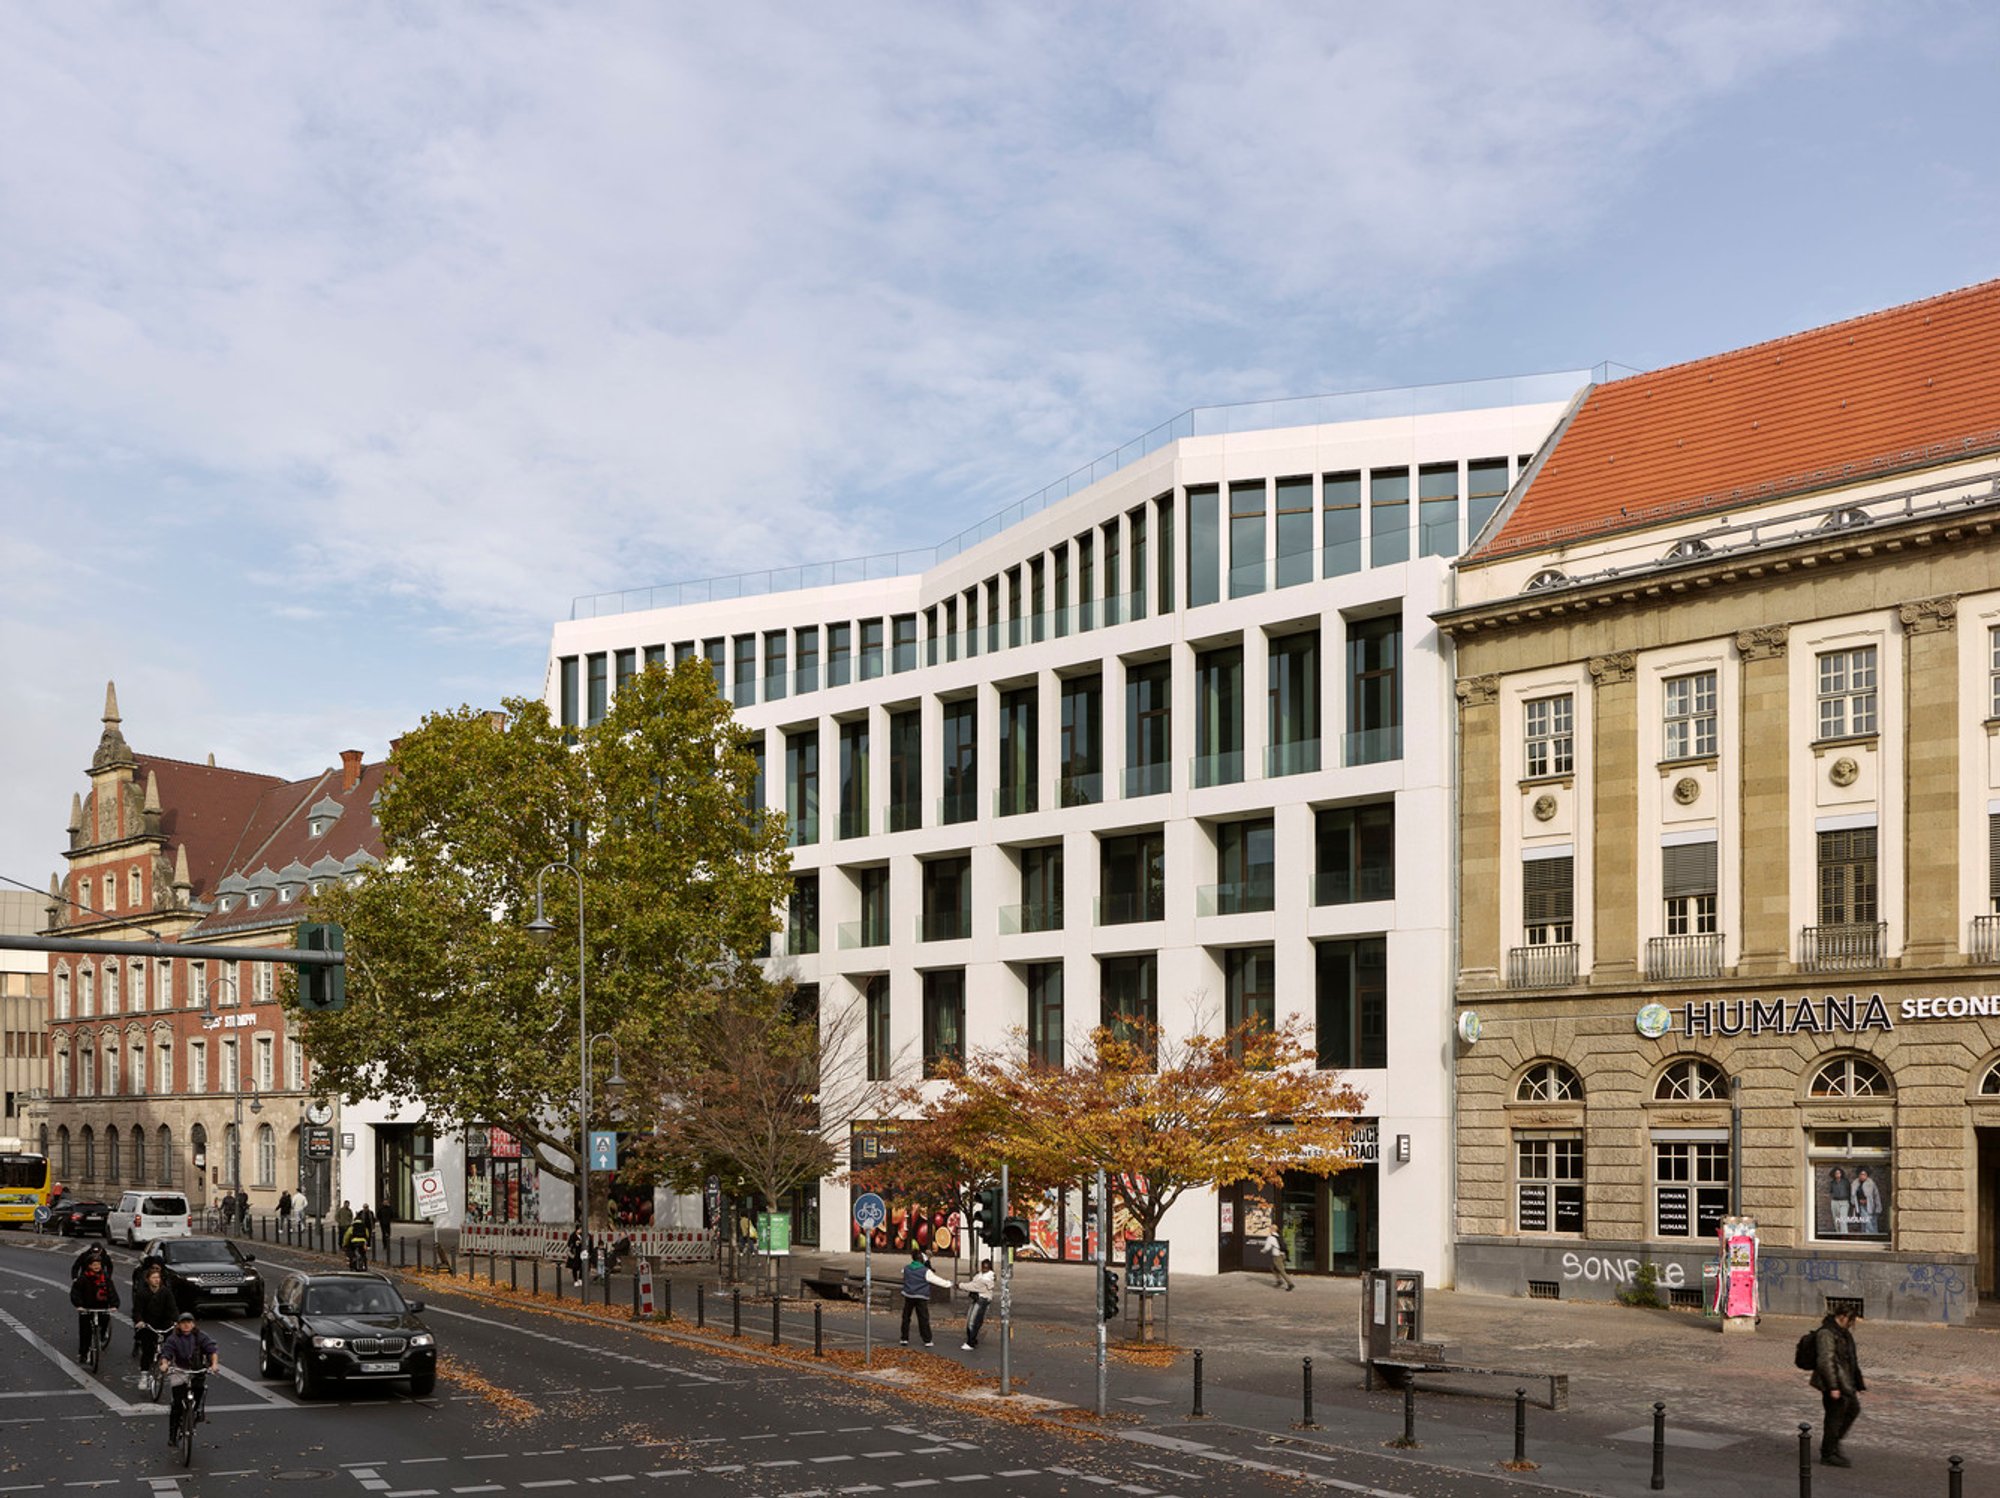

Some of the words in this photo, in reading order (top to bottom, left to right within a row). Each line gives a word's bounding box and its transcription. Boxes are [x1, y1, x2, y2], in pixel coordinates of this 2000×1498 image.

[1685, 993, 1894, 1037] HUMANA
[492, 1134, 521, 1145] HAL
[1400, 1138, 1409, 1153] E
